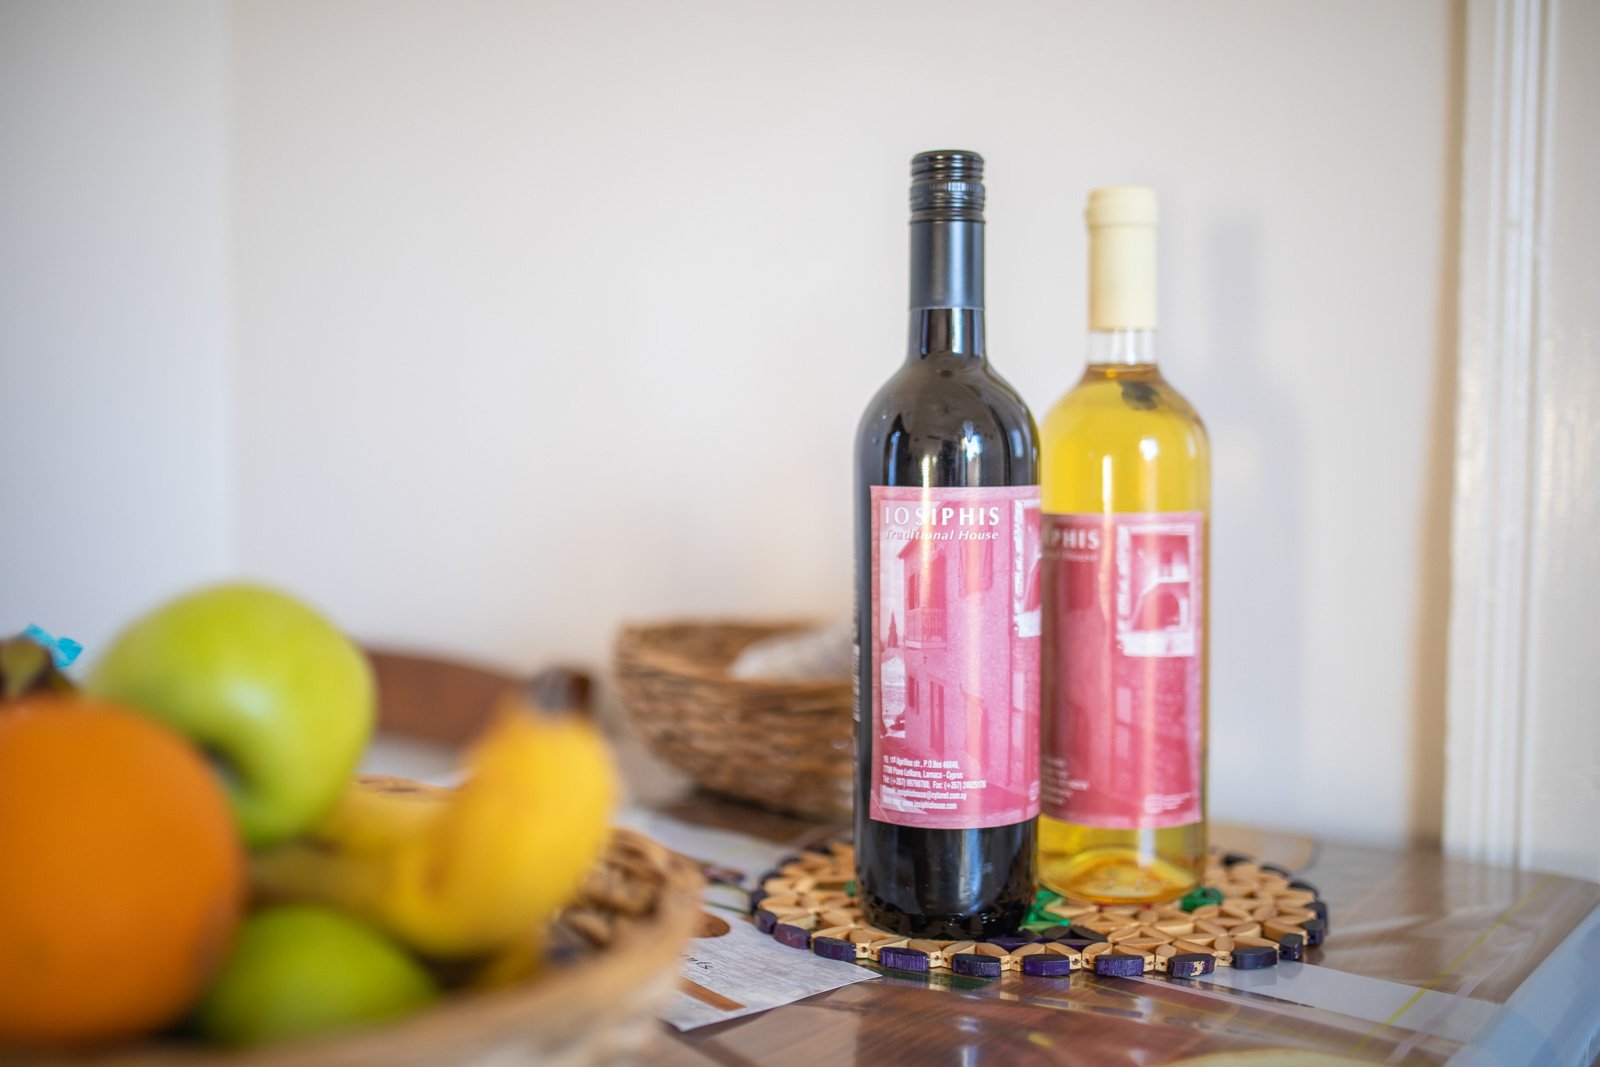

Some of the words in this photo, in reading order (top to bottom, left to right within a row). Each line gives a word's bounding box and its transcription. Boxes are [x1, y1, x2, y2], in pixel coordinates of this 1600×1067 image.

[885, 506, 1000, 526] IOSIPHIS
[886, 529, 955, 541] Traditional
[958, 530, 999, 540] House
[946, 771, 963, 780] Cyprus
[943, 781, 962, 790] (+357)
